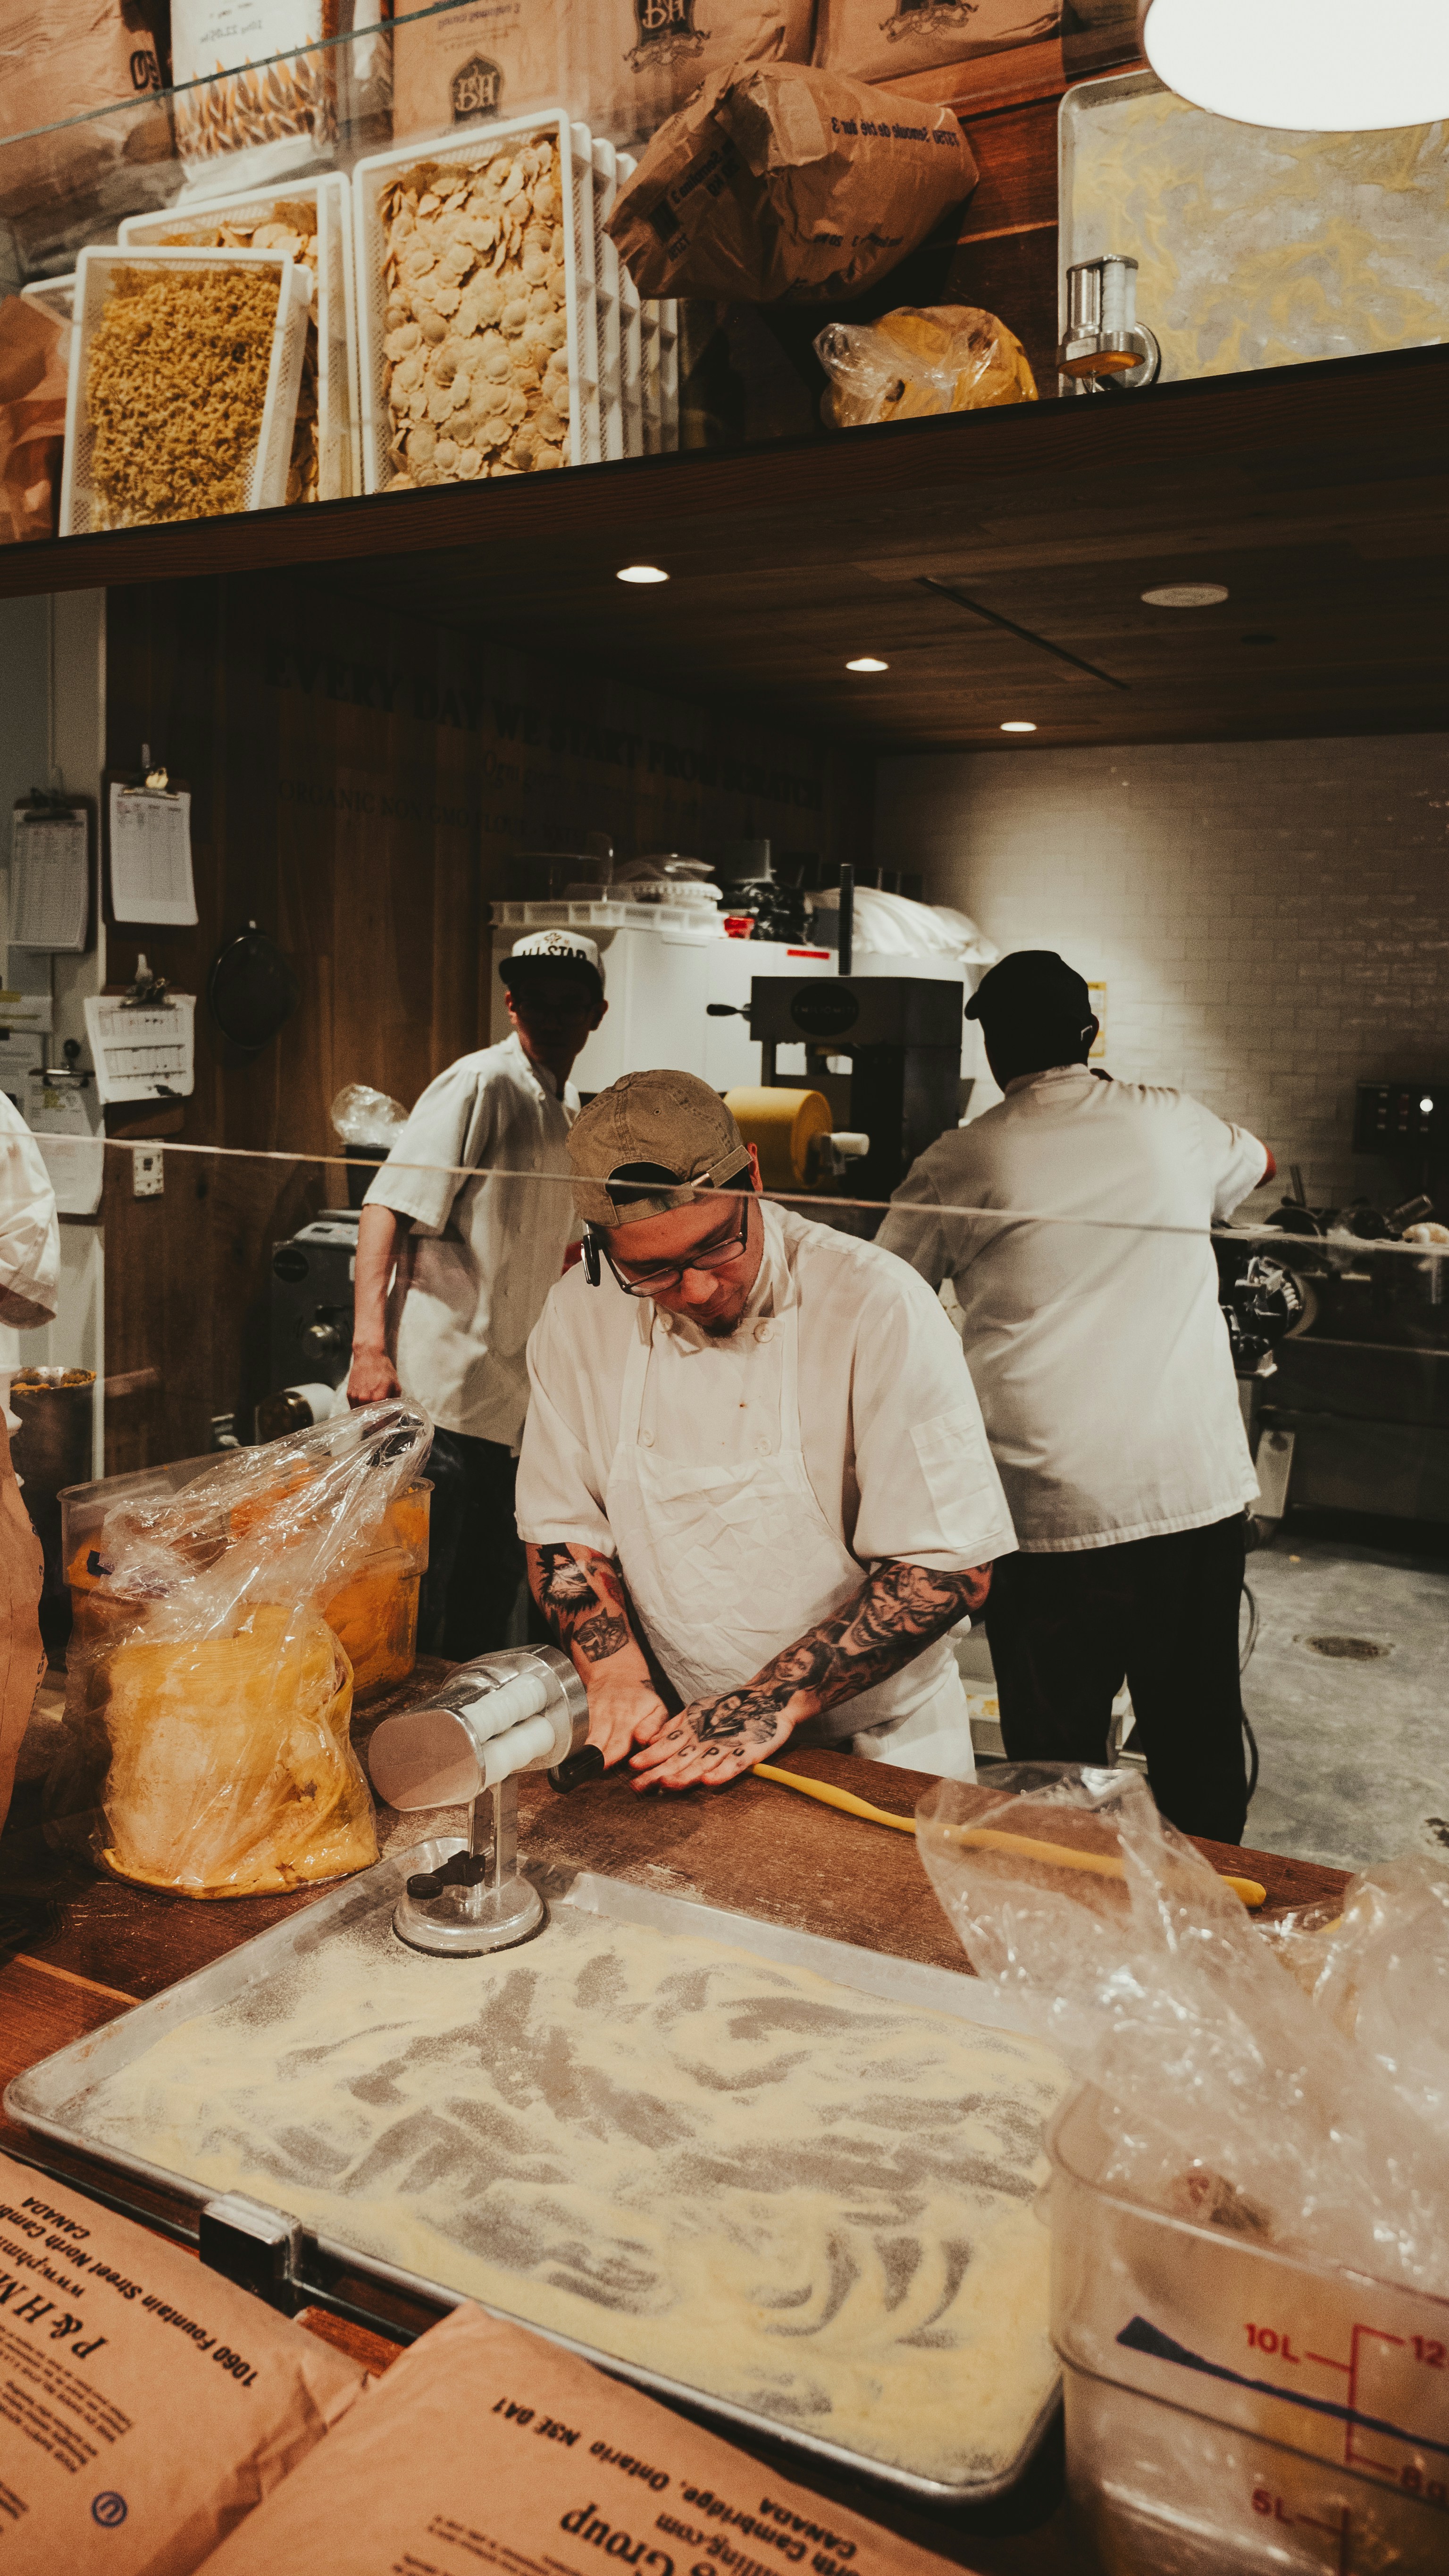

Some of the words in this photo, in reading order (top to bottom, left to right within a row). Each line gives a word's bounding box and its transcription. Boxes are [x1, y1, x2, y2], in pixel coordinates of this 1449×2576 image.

[265, 645, 403, 713] EVERY
[413, 676, 485, 732] DAY
[278, 778, 375, 814] ORGANIC
[0, 2203, 46, 2239] Camb
[22, 2197, 91, 2240] CANADA
[45, 2234, 93, 2267] North
[88, 2261, 142, 2300] Street
[141, 2292, 217, 2352] Fountain
[211, 2342, 260, 2388] 1060
[590, 2441, 670, 2492] Ontario
[760, 2497, 857, 2559] CANADA
